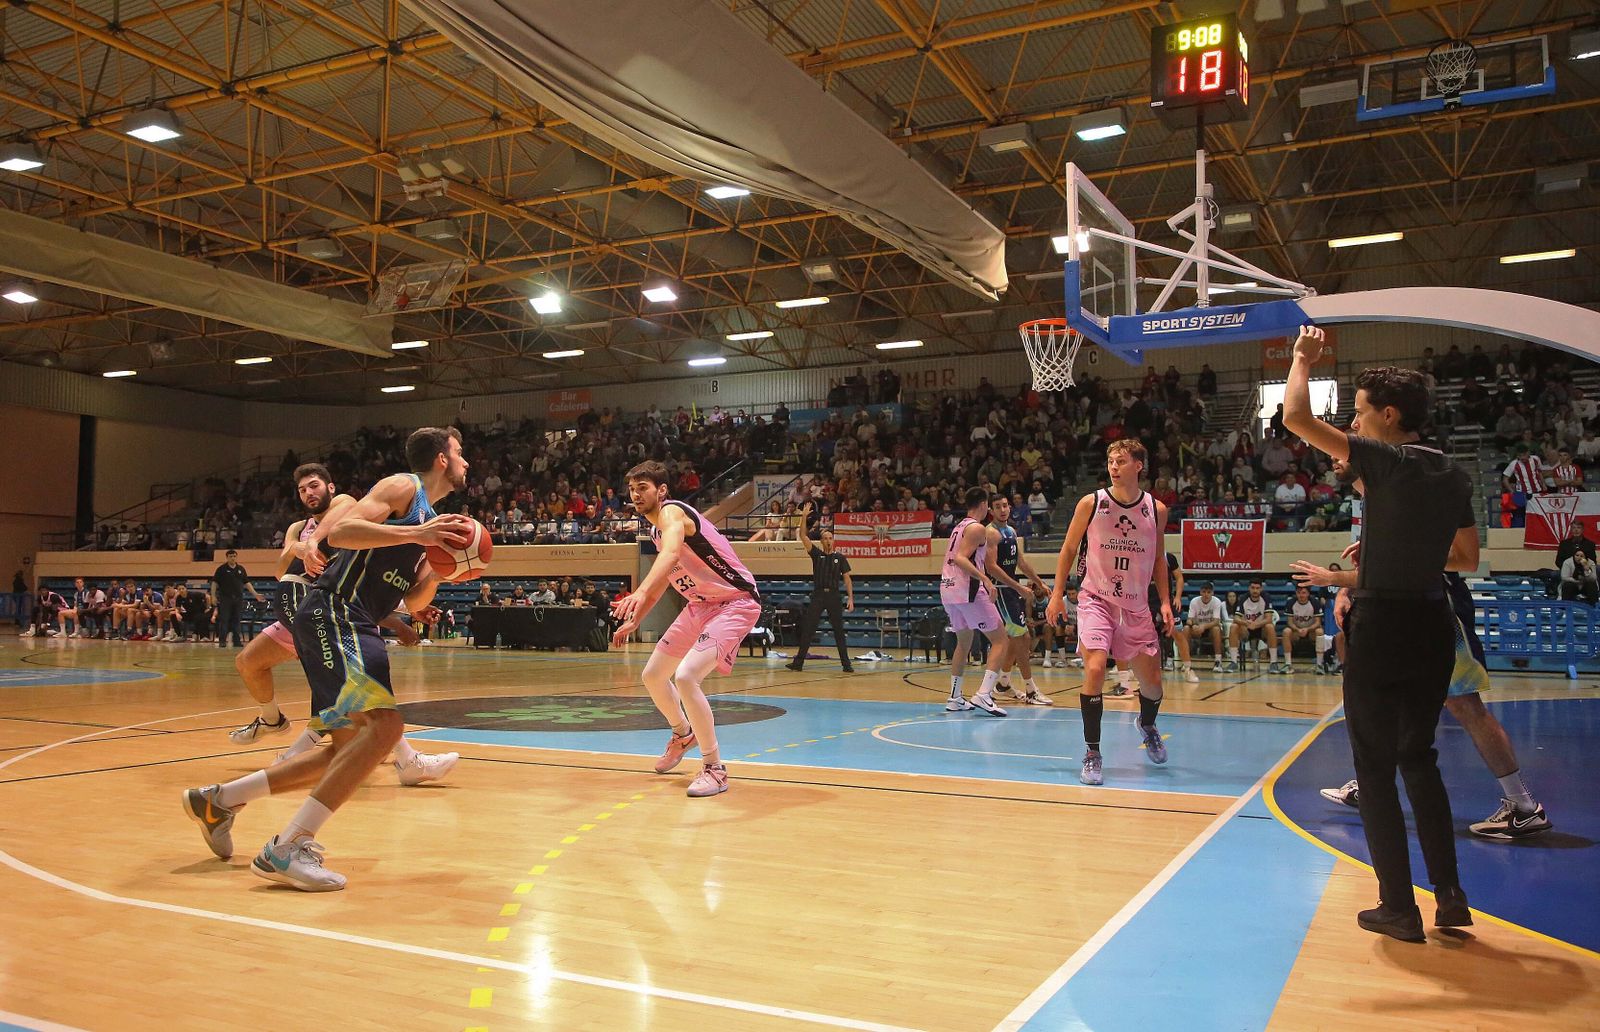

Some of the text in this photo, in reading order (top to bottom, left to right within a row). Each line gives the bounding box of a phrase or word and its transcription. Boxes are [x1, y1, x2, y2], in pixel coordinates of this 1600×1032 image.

[1178, 24, 1221, 50] 9:08
[1179, 50, 1222, 92] 18
[1143, 312, 1247, 331] SPORT SYSTEM
[1089, 350, 1097, 364] C
[712, 380, 719, 393] B
[849, 512, 915, 524] PEÑA 1912
[1194, 521, 1253, 531] KOMANDO
[880, 544, 928, 556] COLORUM
[1100, 543, 1146, 554] PONFERRADA
[1114, 556, 1130, 571] 10
[312, 608, 334, 669] damex.io
